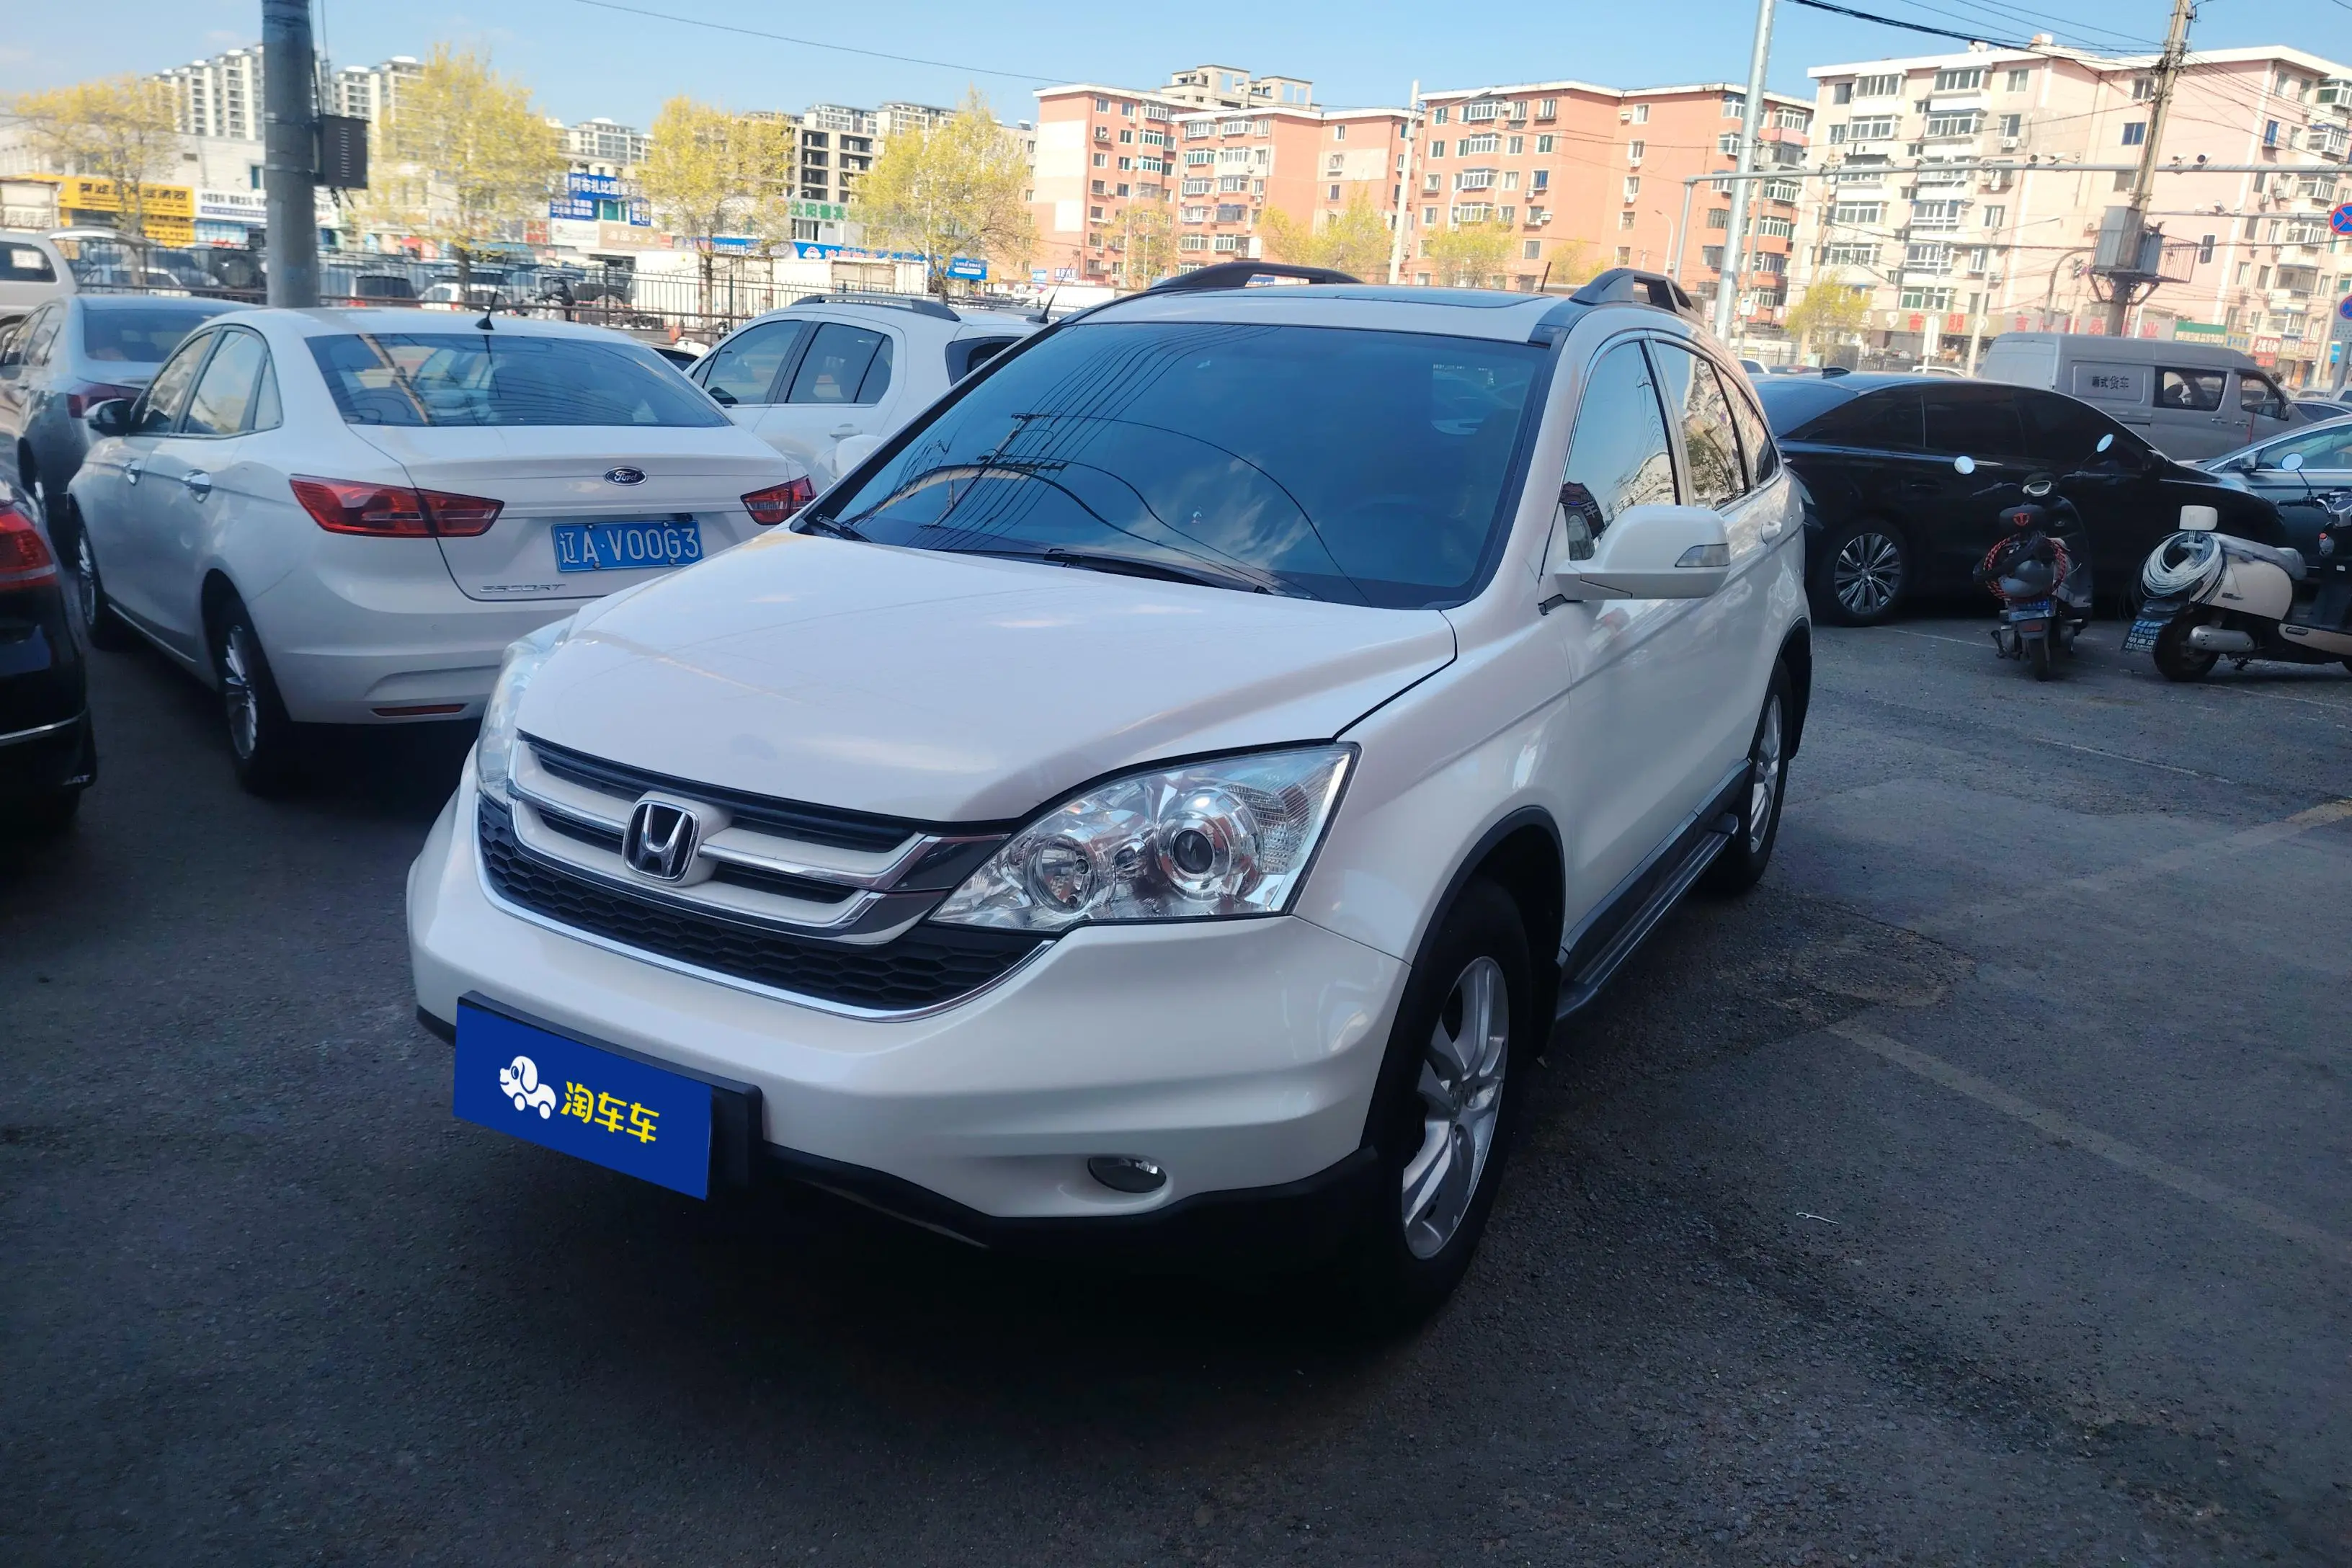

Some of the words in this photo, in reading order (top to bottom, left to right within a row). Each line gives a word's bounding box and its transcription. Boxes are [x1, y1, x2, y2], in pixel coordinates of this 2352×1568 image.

[571, 177, 641, 196] 阿布扎比国家
[614, 470, 638, 481] Ford
[480, 584, 566, 593] ESCORT
